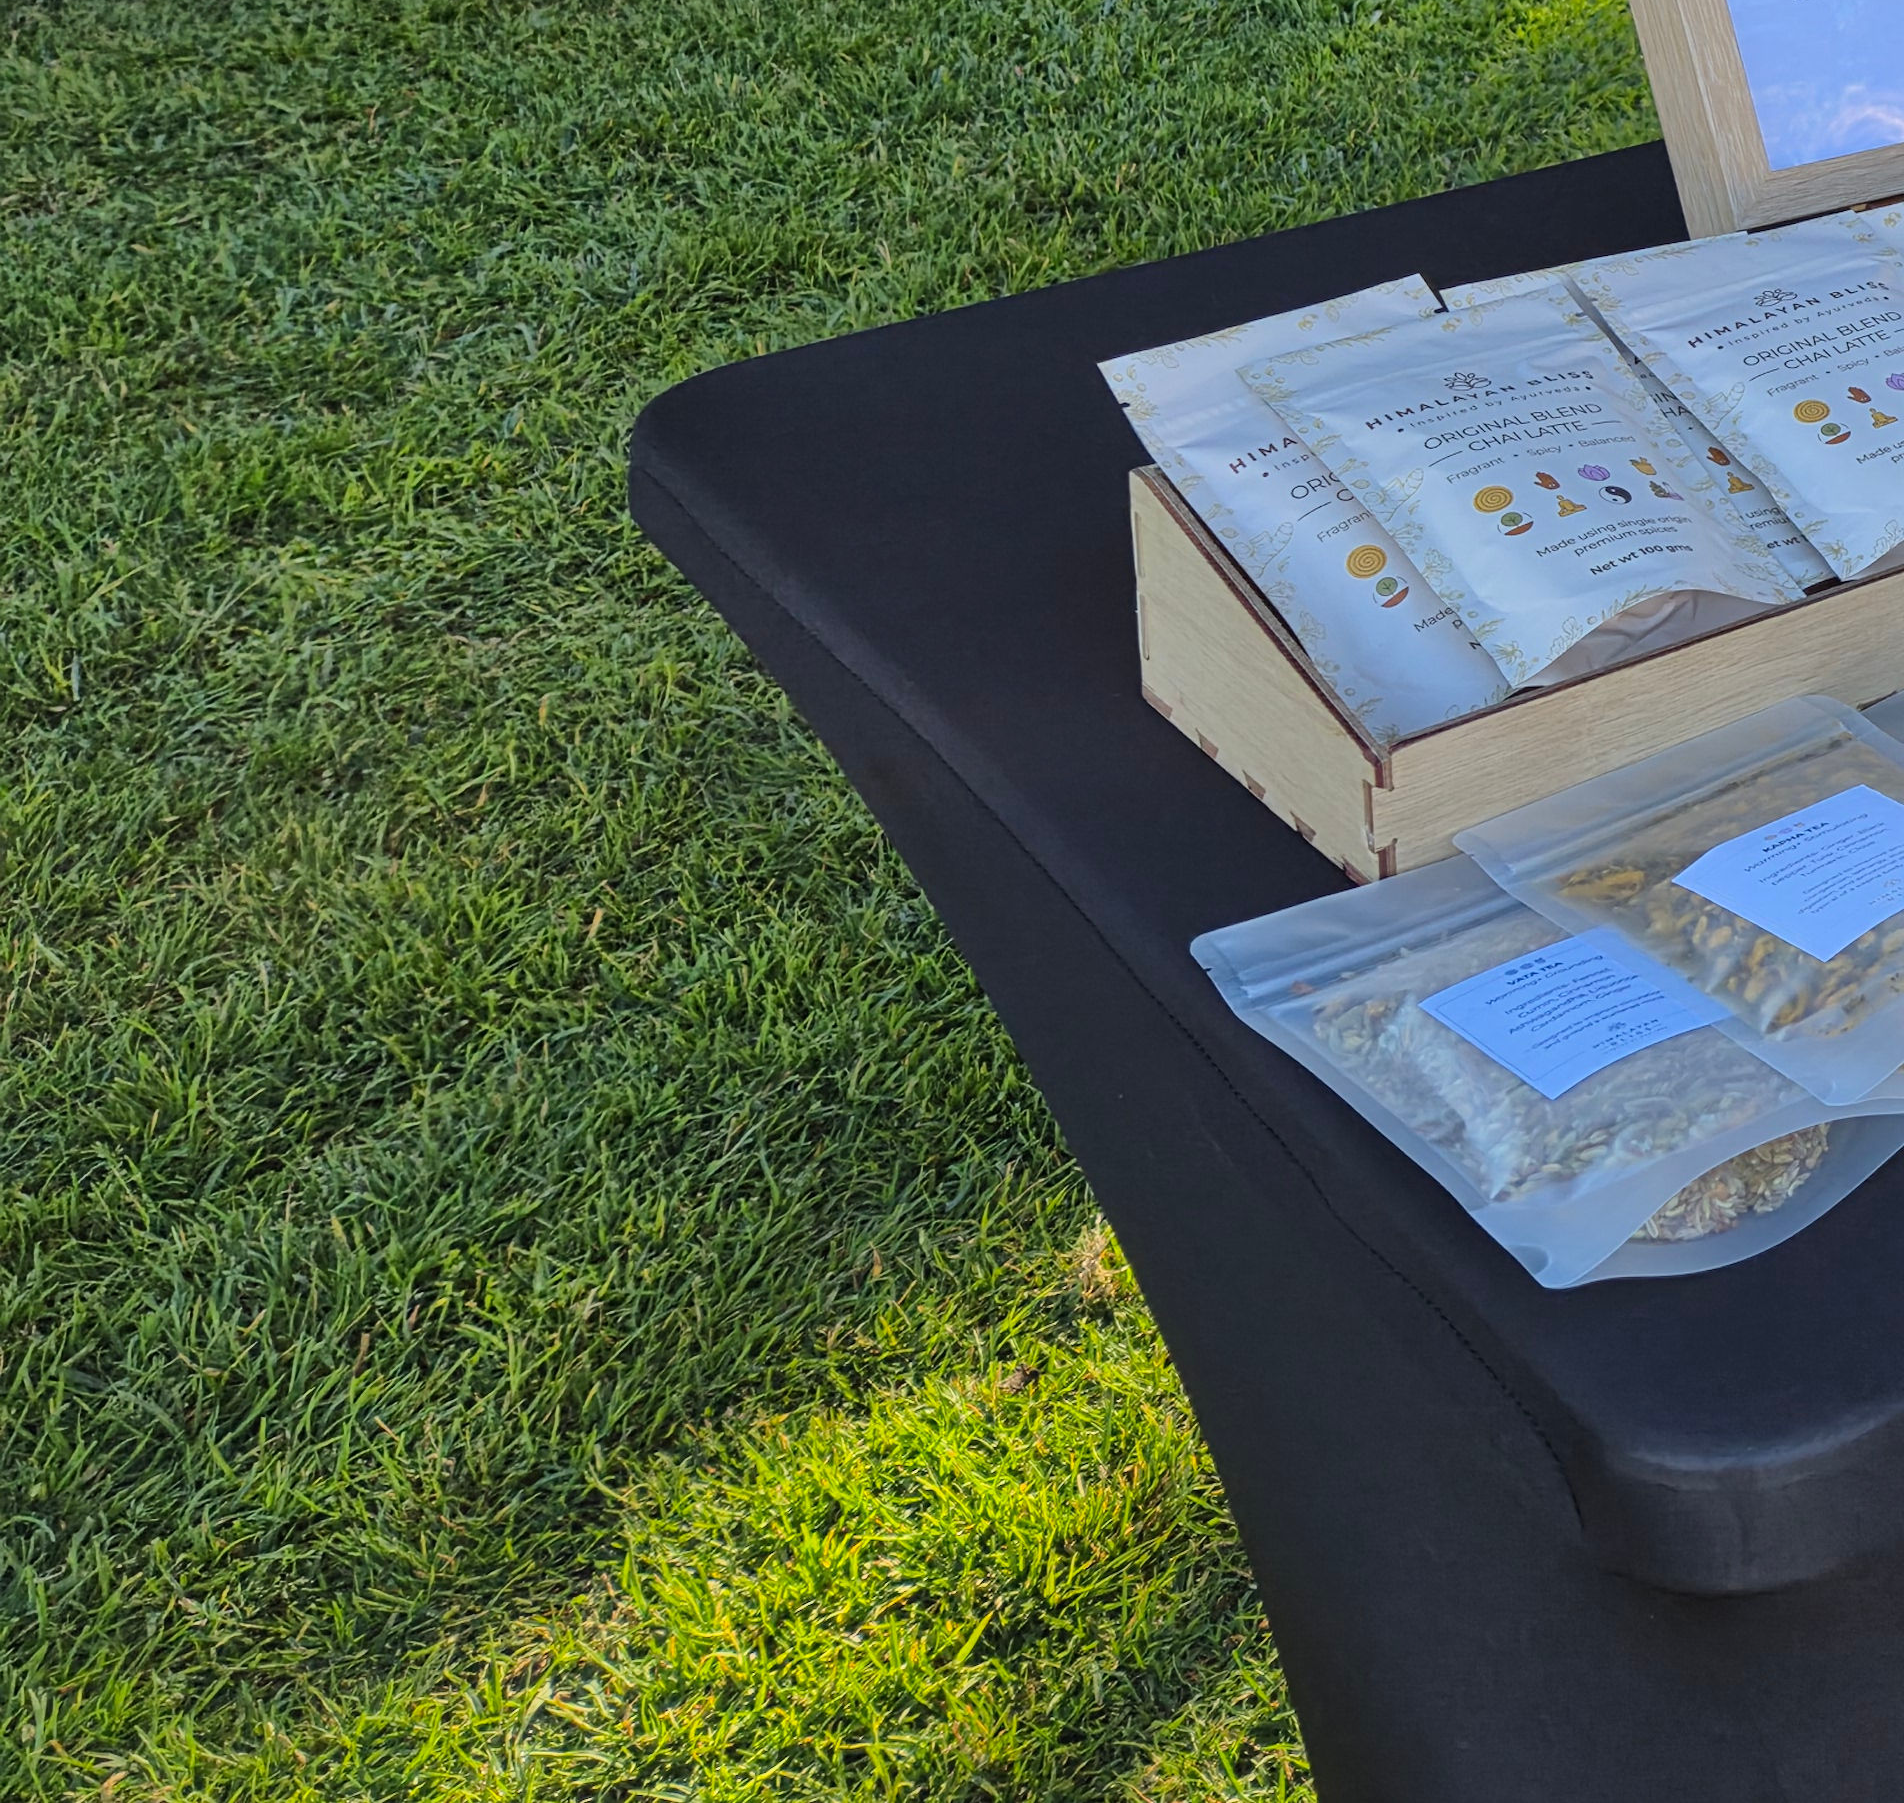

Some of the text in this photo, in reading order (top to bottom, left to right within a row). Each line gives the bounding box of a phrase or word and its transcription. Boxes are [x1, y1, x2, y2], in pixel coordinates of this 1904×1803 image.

[1688, 280, 1887, 349] HIMALAYAN BLISS
[1743, 310, 1903, 368] ORIGINAL BLEND
[1783, 330, 1892, 372] CHAI LATTE
[1364, 368, 1596, 432] HIMALAYAN BLISS
[1409, 402, 1480, 430] Inspired
[1484, 398, 1504, 410] by
[1423, 402, 1603, 451] ORIGINAL BLEND
[1466, 420, 1589, 453] CHAI LATTE
[1445, 434, 1636, 485] Fragrant Spicy Balanced
[1536, 516, 1657, 558] Made using single
[1573, 523, 1678, 559] premium spices
[1589, 544, 1665, 577] Net wt 100
[1414, 605, 1455, 634] Made
